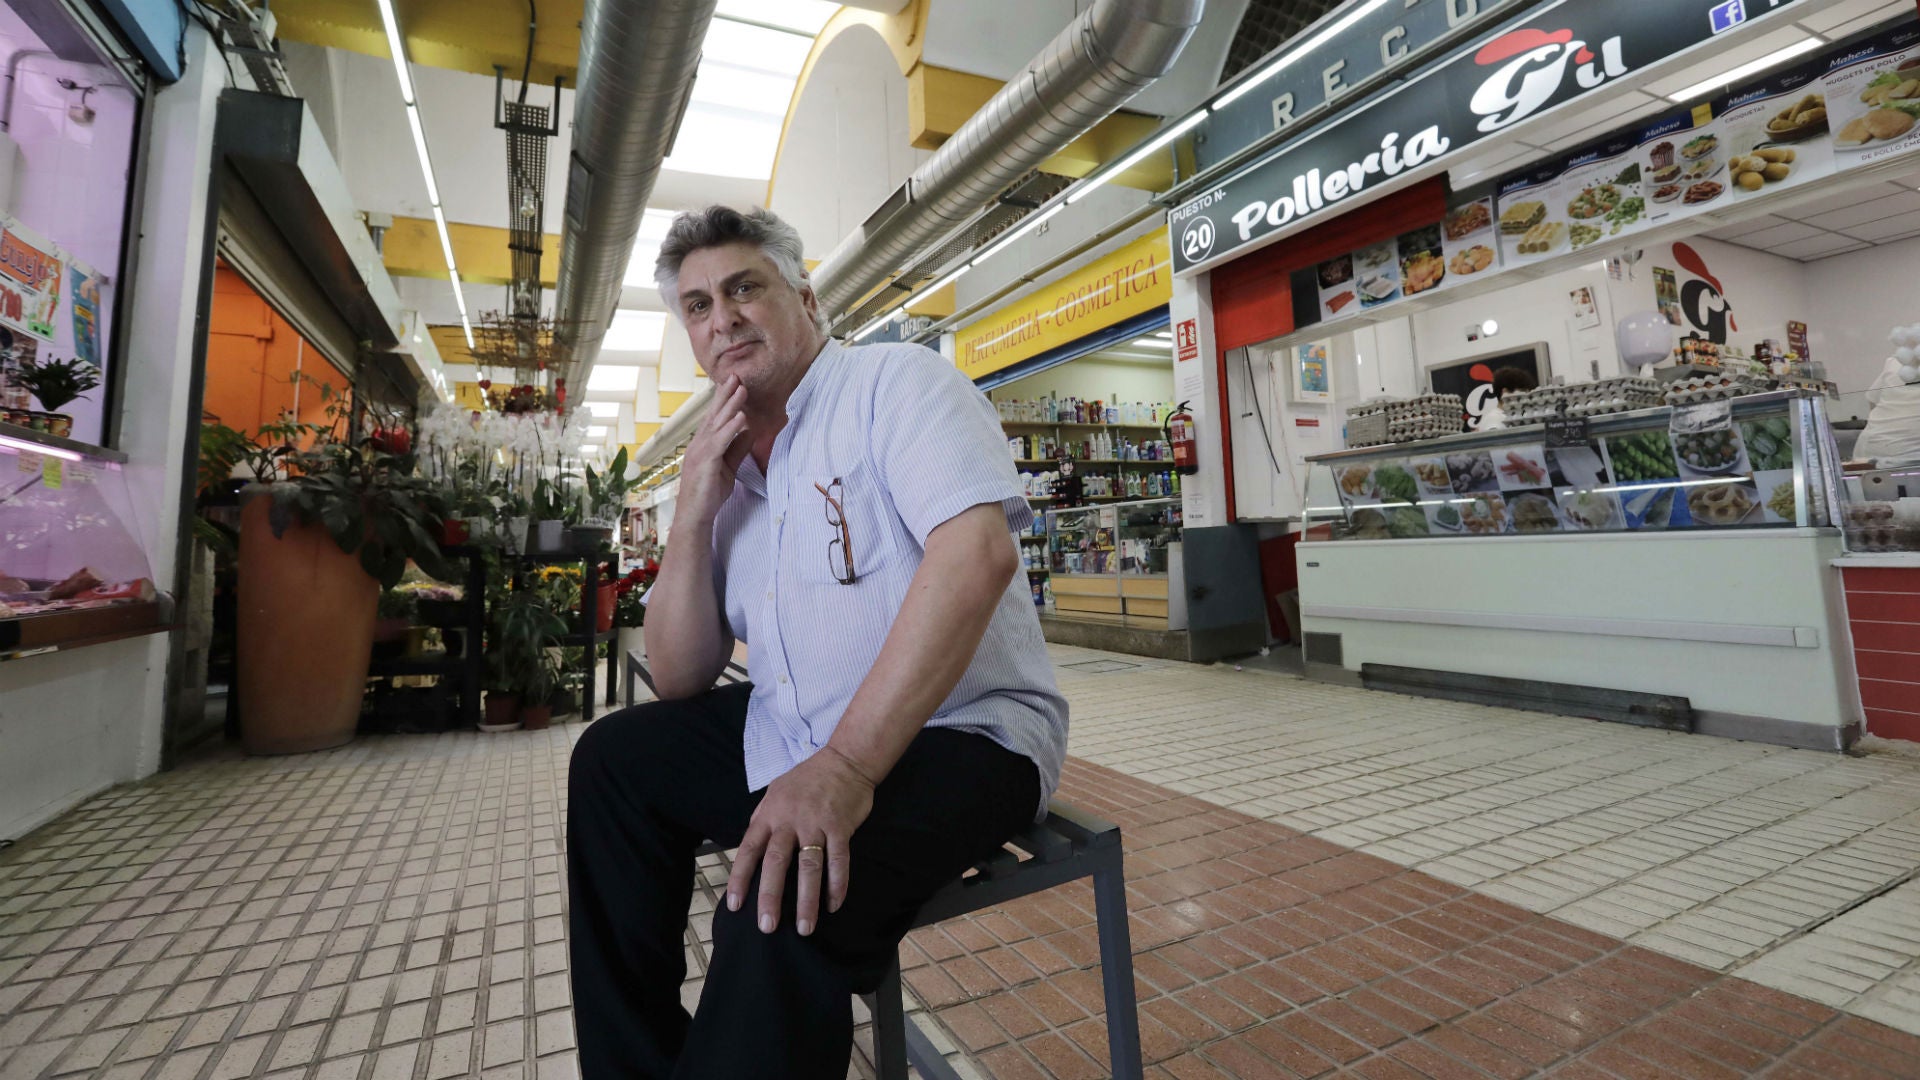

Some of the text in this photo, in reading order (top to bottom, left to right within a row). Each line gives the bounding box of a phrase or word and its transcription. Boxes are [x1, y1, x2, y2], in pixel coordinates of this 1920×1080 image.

[1829, 46, 1875, 68] Maheso
[1825, 54, 1906, 87] NUGGETS DE POLLO
[1727, 87, 1766, 107] Maheso
[1724, 104, 1766, 124] CROQUETAS
[1644, 119, 1681, 139] Maheso
[1861, 153, 1872, 161] DE
[1874, 144, 1902, 157] POLLO
[1172, 195, 1213, 224] PUESTO
[1185, 223, 1212, 257] 20
[964, 307, 1041, 368] PERFUMERIA
[1053, 254, 1159, 328] COSMETICA
